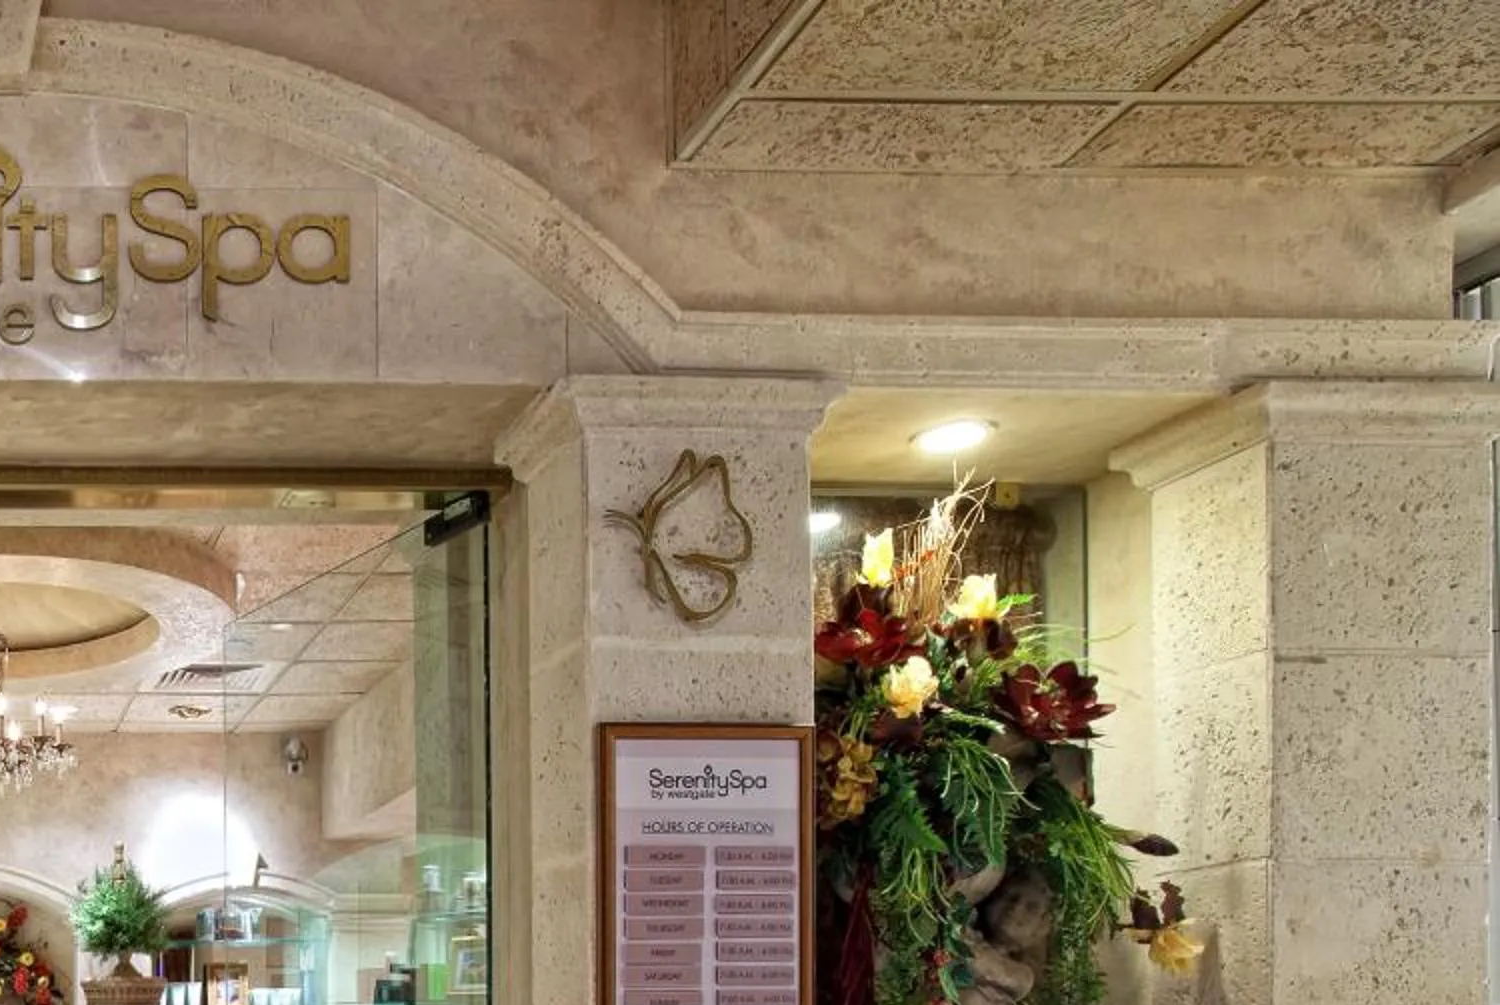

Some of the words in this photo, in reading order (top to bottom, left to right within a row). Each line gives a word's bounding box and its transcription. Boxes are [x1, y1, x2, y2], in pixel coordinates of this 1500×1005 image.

[651, 790, 665, 801] by
[667, 788, 716, 801] westgate
[642, 820, 685, 834] HOURS
[687, 820, 705, 834] OF
[707, 820, 775, 834] OPERATION
